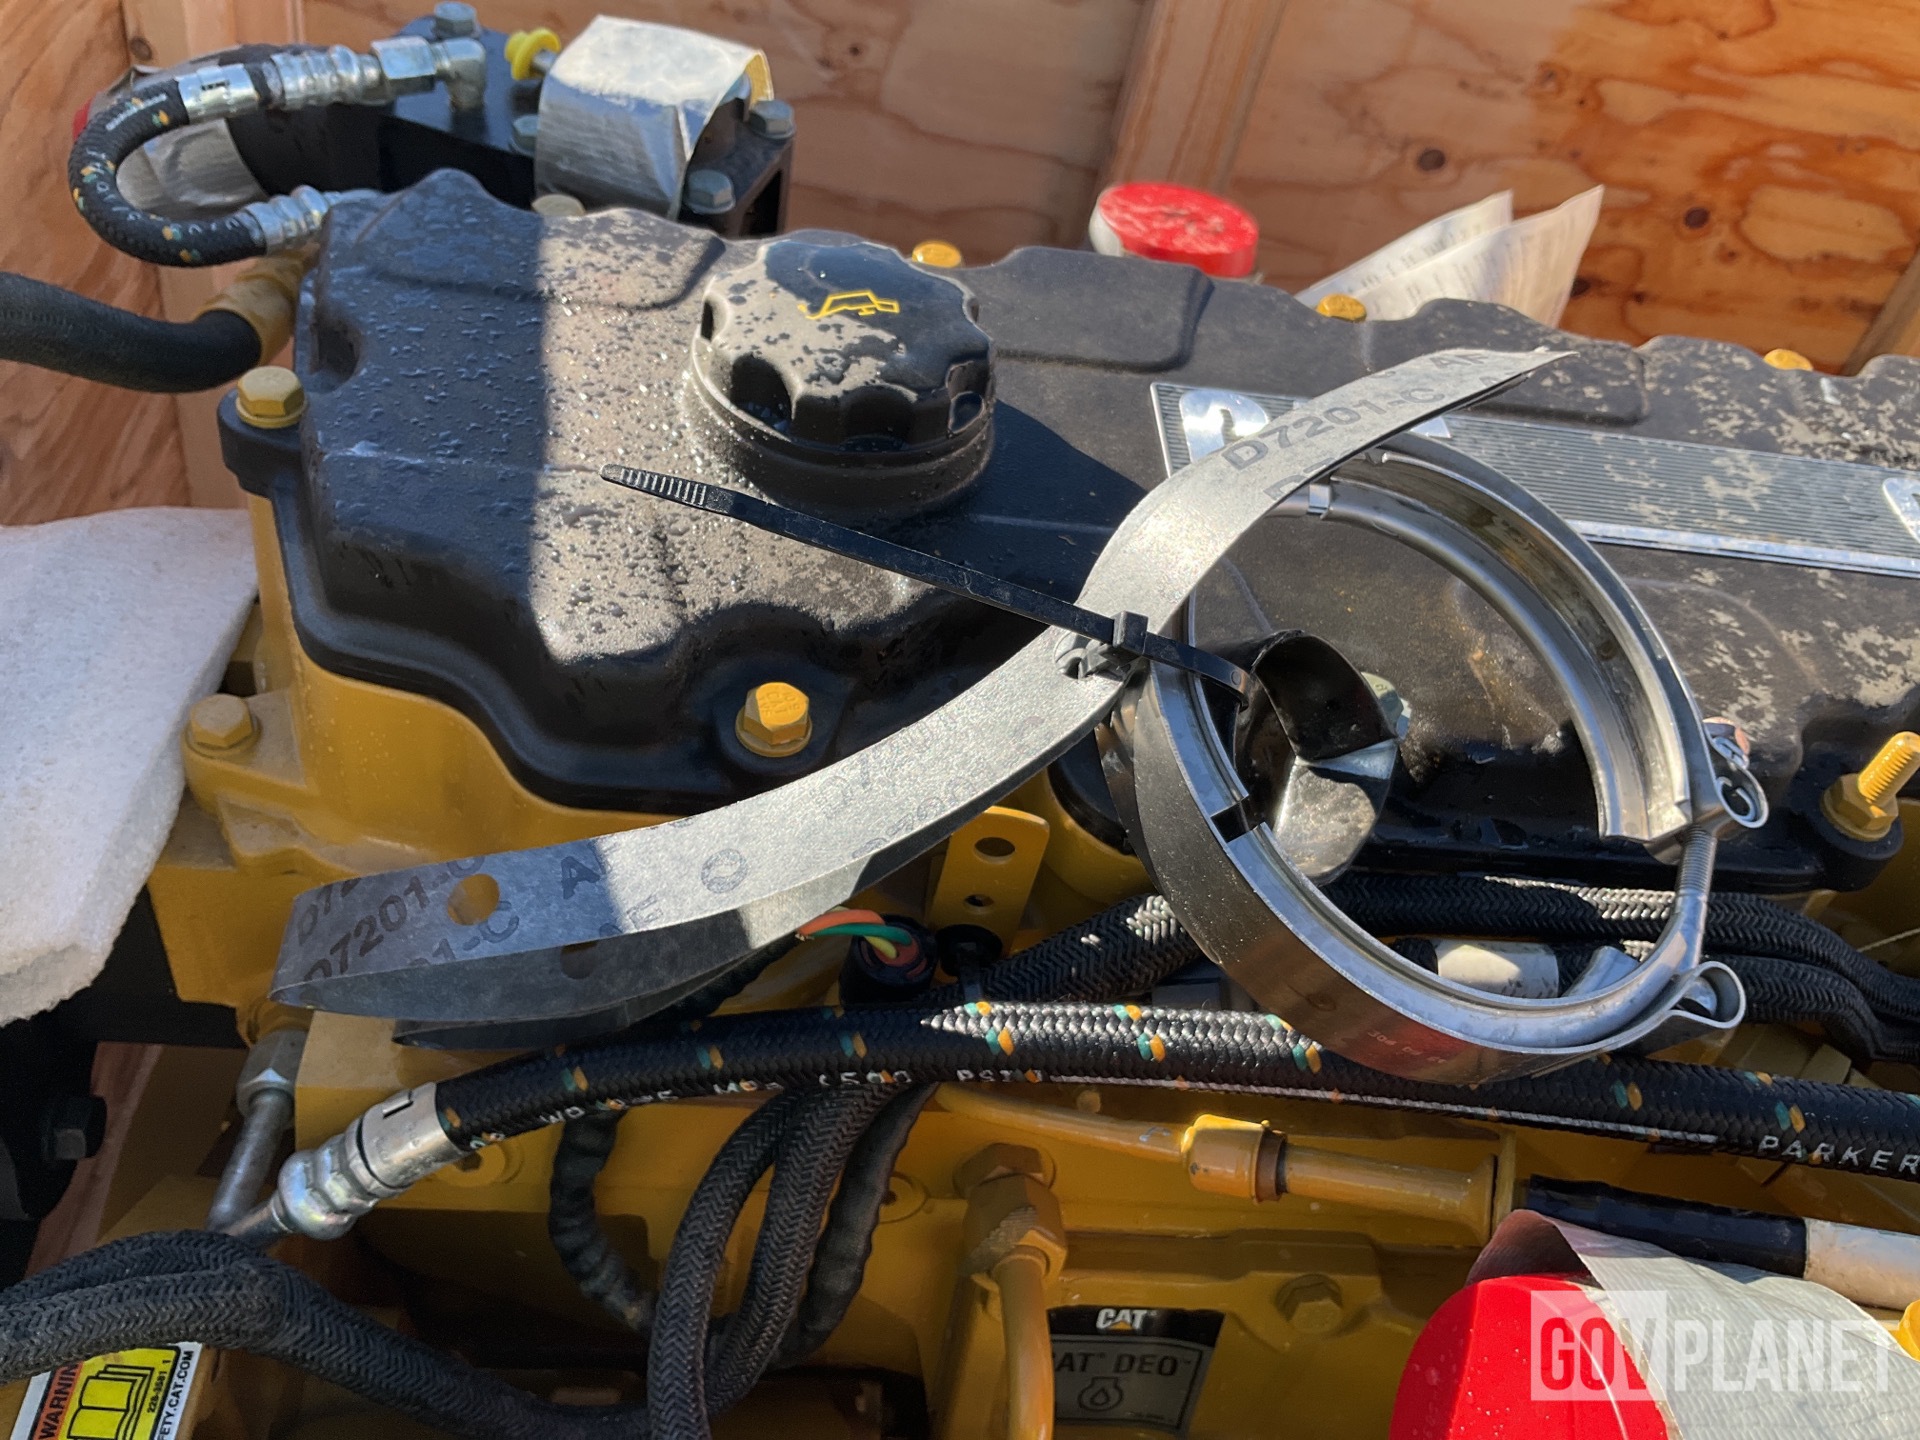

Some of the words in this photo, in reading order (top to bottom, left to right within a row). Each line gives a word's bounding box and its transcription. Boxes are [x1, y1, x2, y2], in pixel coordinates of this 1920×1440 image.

[1221, 388, 1445, 471] D7201-C
[1758, 1135, 1920, 1175] PARKER
[1096, 1308, 1149, 1330] CAT
[1052, 1353, 1095, 1373] AT
[1113, 1353, 1179, 1377] DEO
